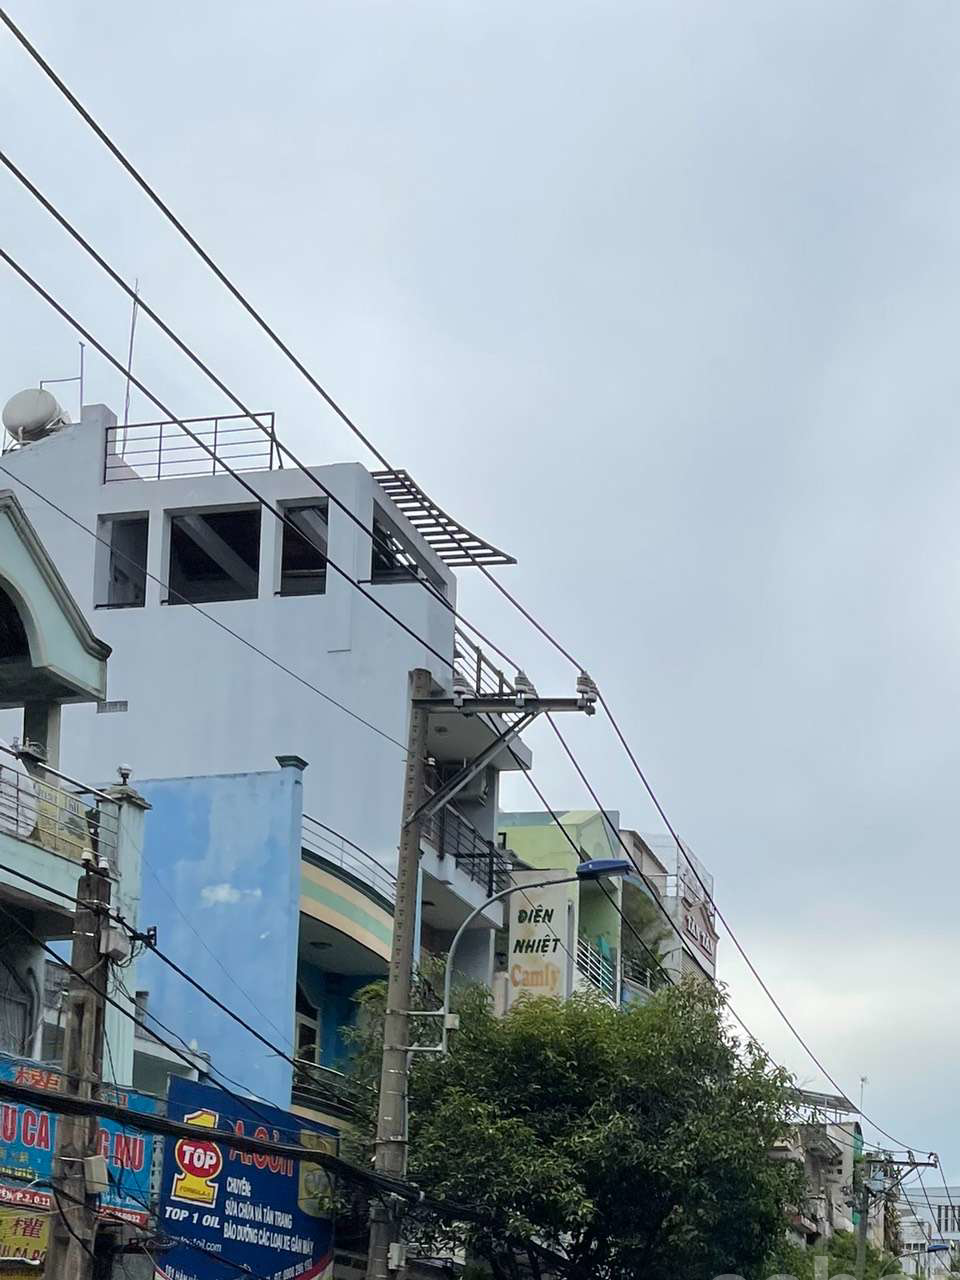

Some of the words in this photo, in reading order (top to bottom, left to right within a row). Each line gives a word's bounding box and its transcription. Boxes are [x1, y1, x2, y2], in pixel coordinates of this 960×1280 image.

[518, 904, 554, 928] ĐIỆN
[513, 935, 561, 957] NHIỆT
[181, 1144, 217, 1170] TOP
[165, 1206, 189, 1222] TOP
[191, 1212, 199, 1224] 1
[202, 1215, 221, 1229] OIL
